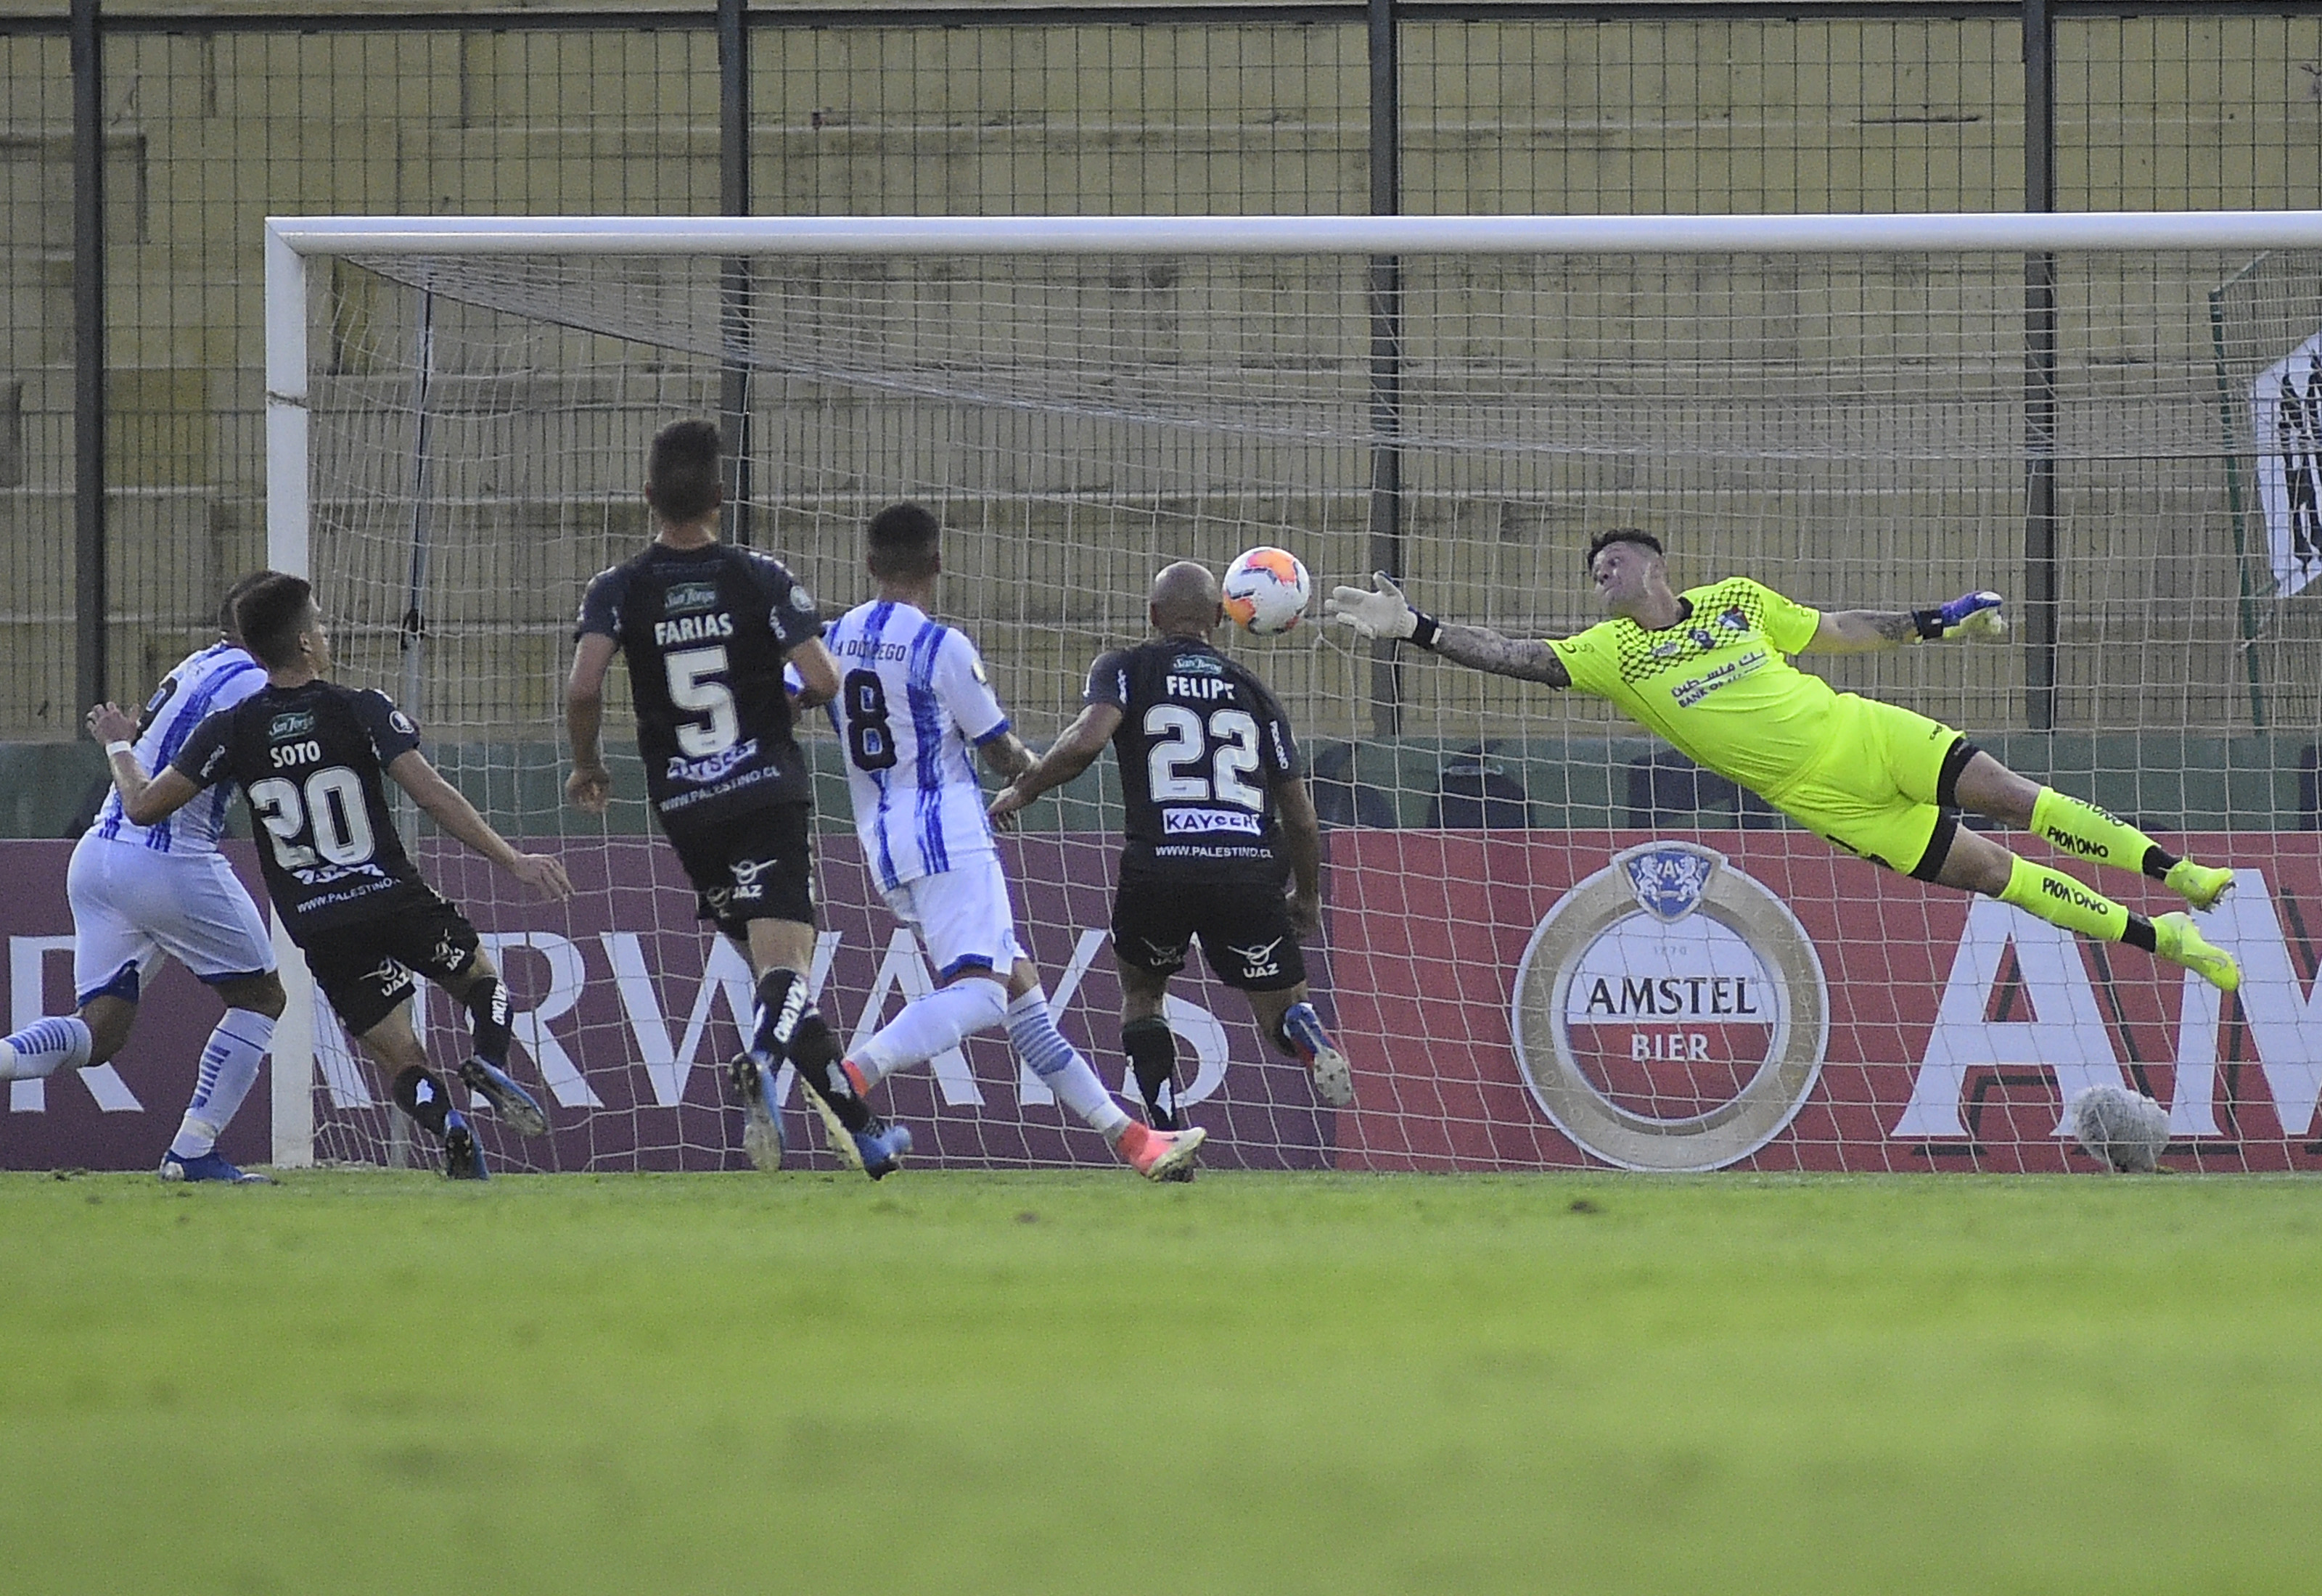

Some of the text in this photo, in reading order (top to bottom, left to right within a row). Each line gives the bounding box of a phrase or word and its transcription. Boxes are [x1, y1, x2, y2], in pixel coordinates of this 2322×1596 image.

[655, 613, 734, 646] FARIAS
[664, 644, 739, 757] 5
[1678, 688, 1708, 708] BANK
[843, 667, 898, 773] 8
[270, 740, 321, 768] SOTO
[1144, 703, 1264, 813] 22
[247, 765, 376, 871] 20
[1154, 845, 1274, 860] WWW.PALESTINO.CL
[381, 971, 410, 997] UAZ
[1243, 962, 1280, 979] UAZ
[1586, 976, 1757, 1015] AMSTEL
[1631, 1033, 1711, 1062] BIER
